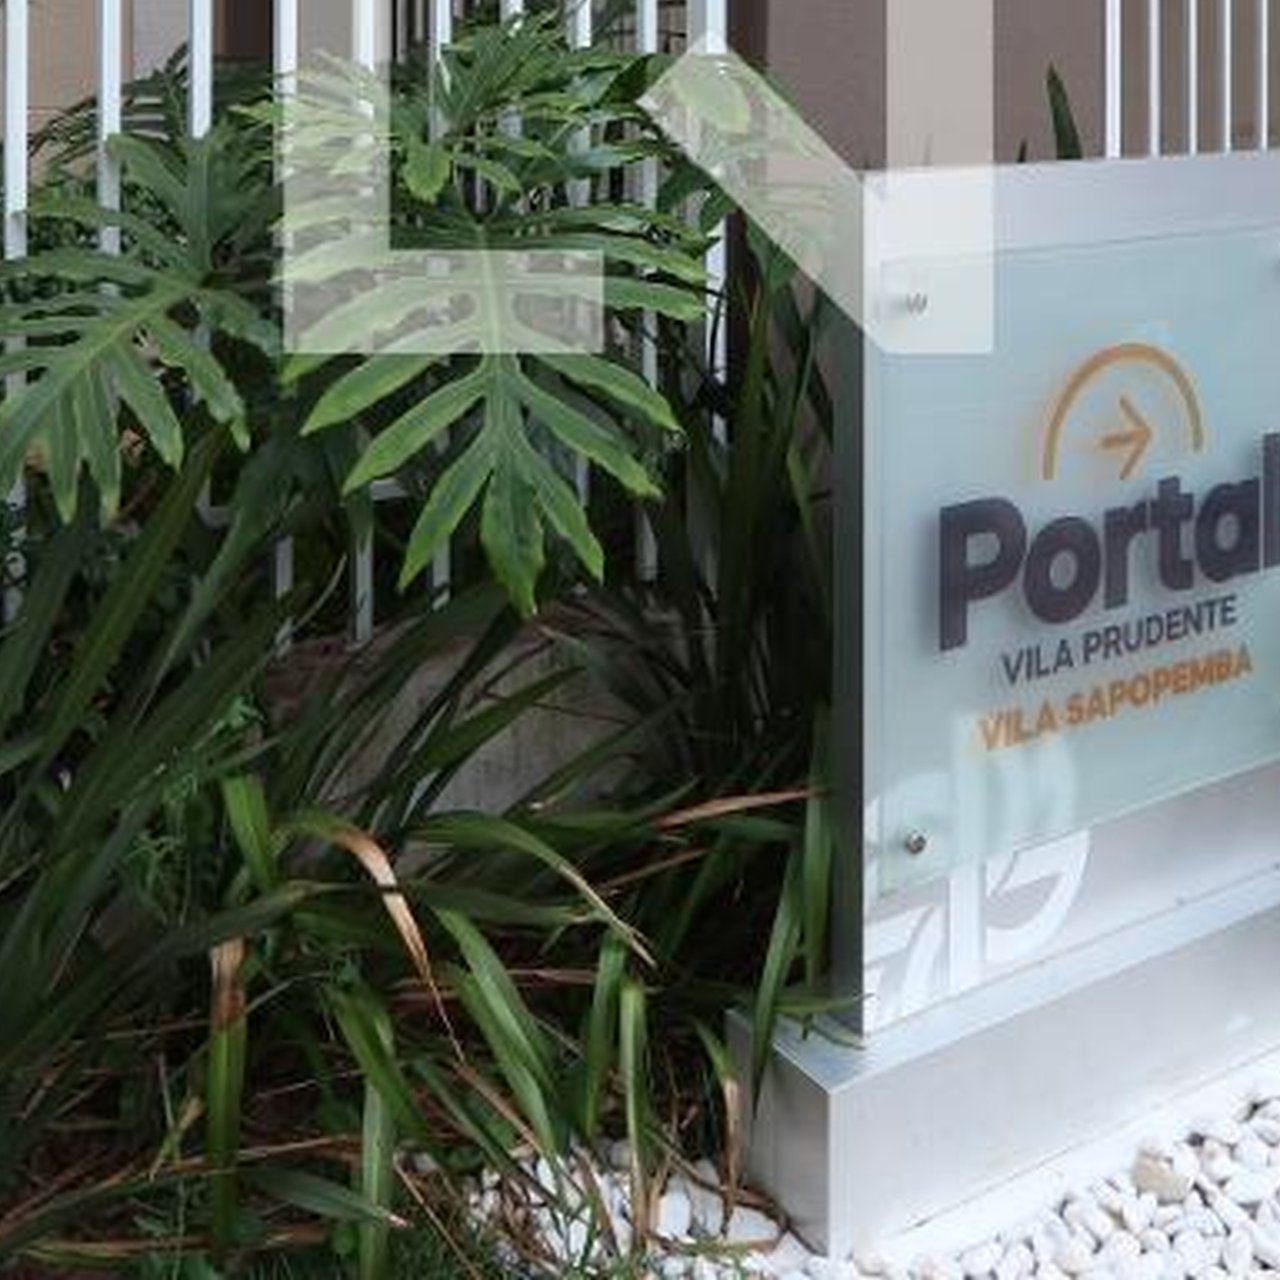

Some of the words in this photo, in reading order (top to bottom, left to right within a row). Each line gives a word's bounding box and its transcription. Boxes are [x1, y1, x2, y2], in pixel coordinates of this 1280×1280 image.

[1000, 638, 1076, 686] VILA
[1082, 595, 1239, 666] PRUDENTE
[979, 698, 1060, 751] VILA
[1065, 643, 1254, 724] SAPOPEMBA
